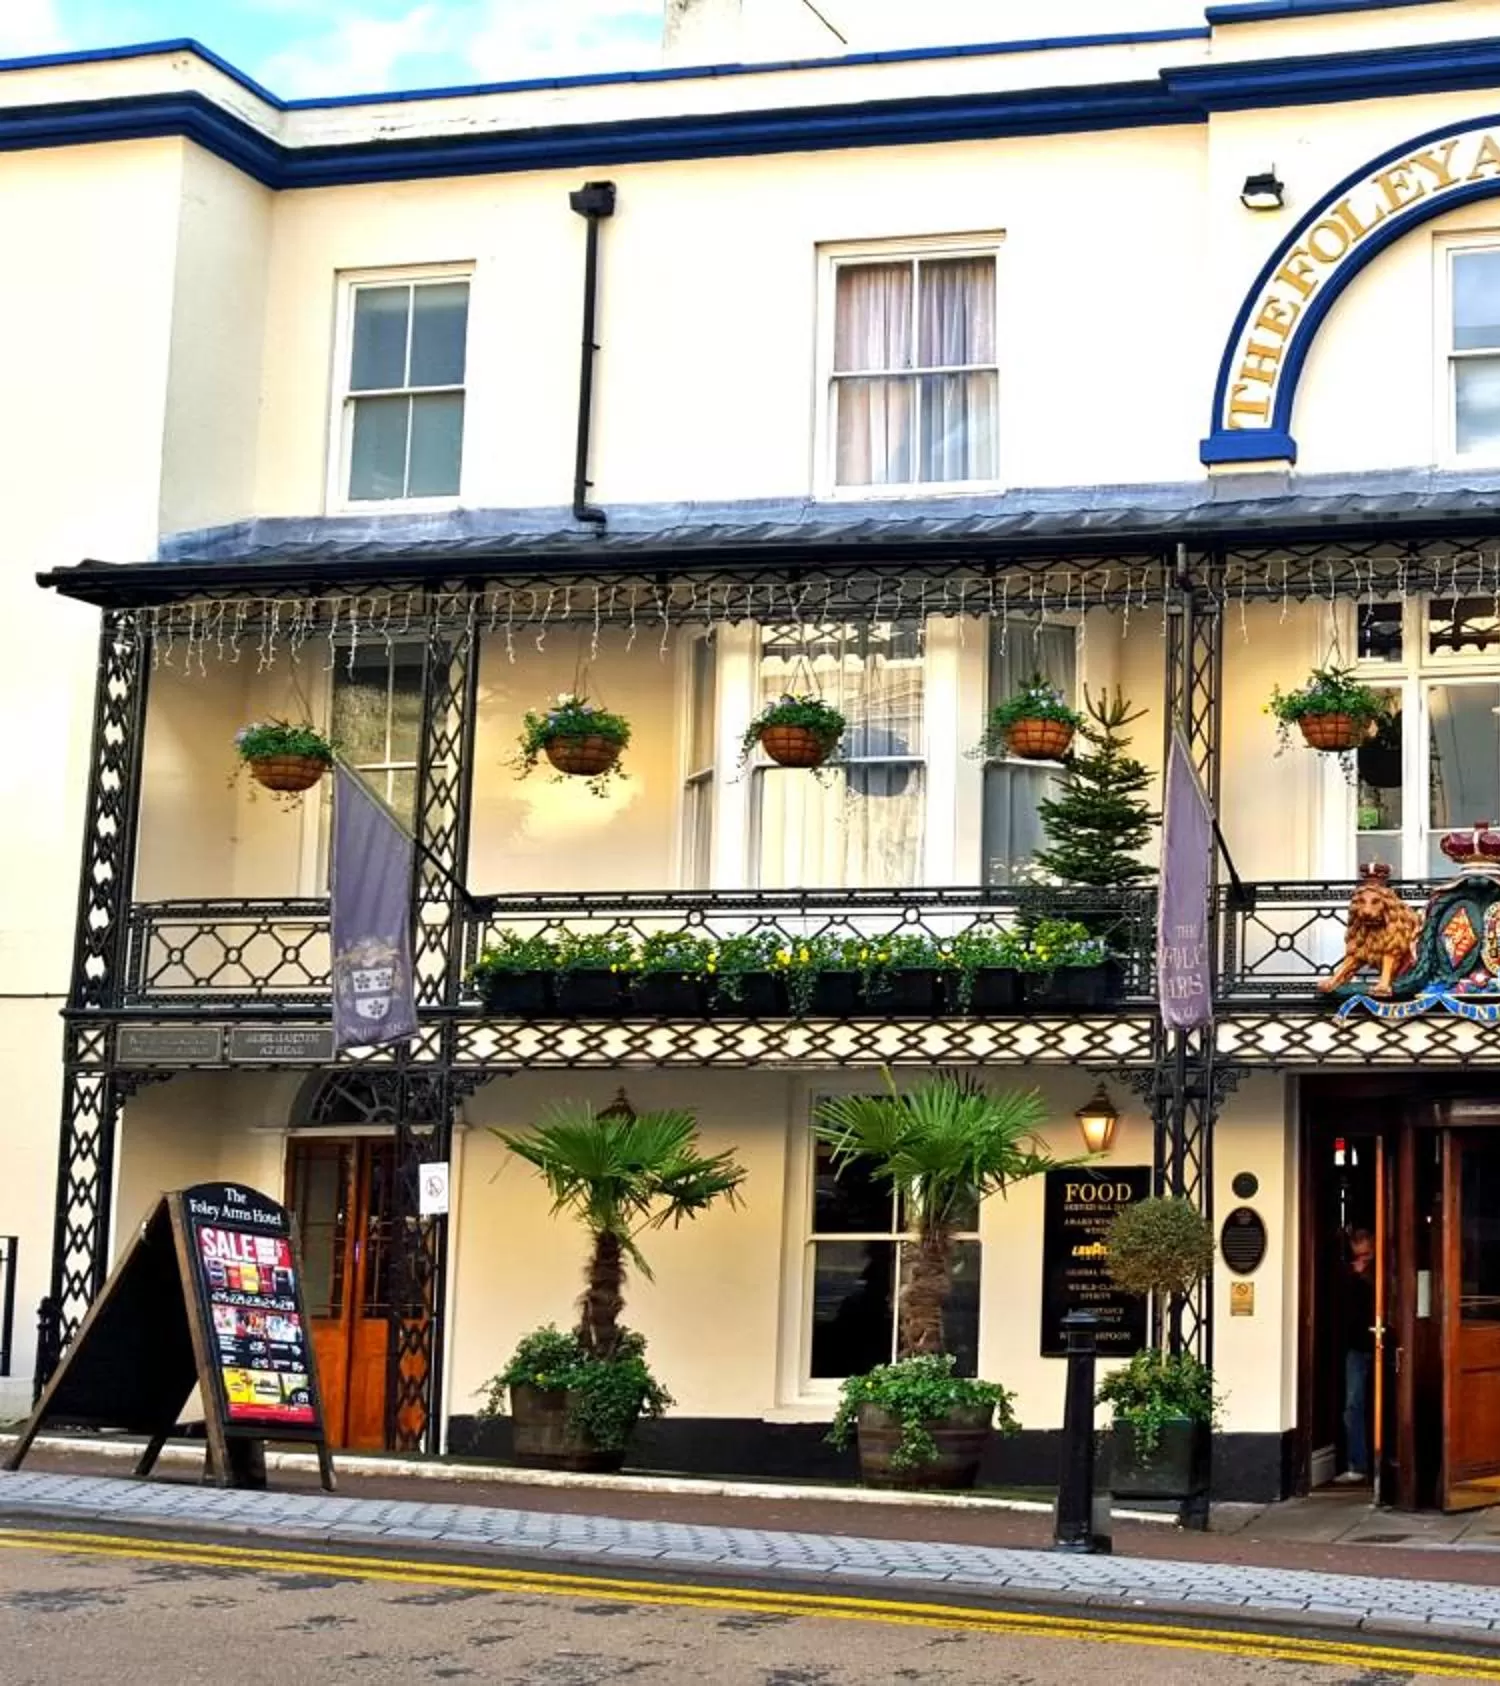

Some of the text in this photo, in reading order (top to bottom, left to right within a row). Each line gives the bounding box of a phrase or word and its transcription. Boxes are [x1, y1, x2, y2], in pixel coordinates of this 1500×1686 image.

[1229, 296, 1300, 431] THE
[1274, 140, 1462, 302] FOLEY
[223, 1187, 248, 1204] The
[1064, 1182, 1133, 1203] FOOD
[189, 1199, 282, 1226] Foley Arms Hotel
[201, 1226, 257, 1264] SALE
